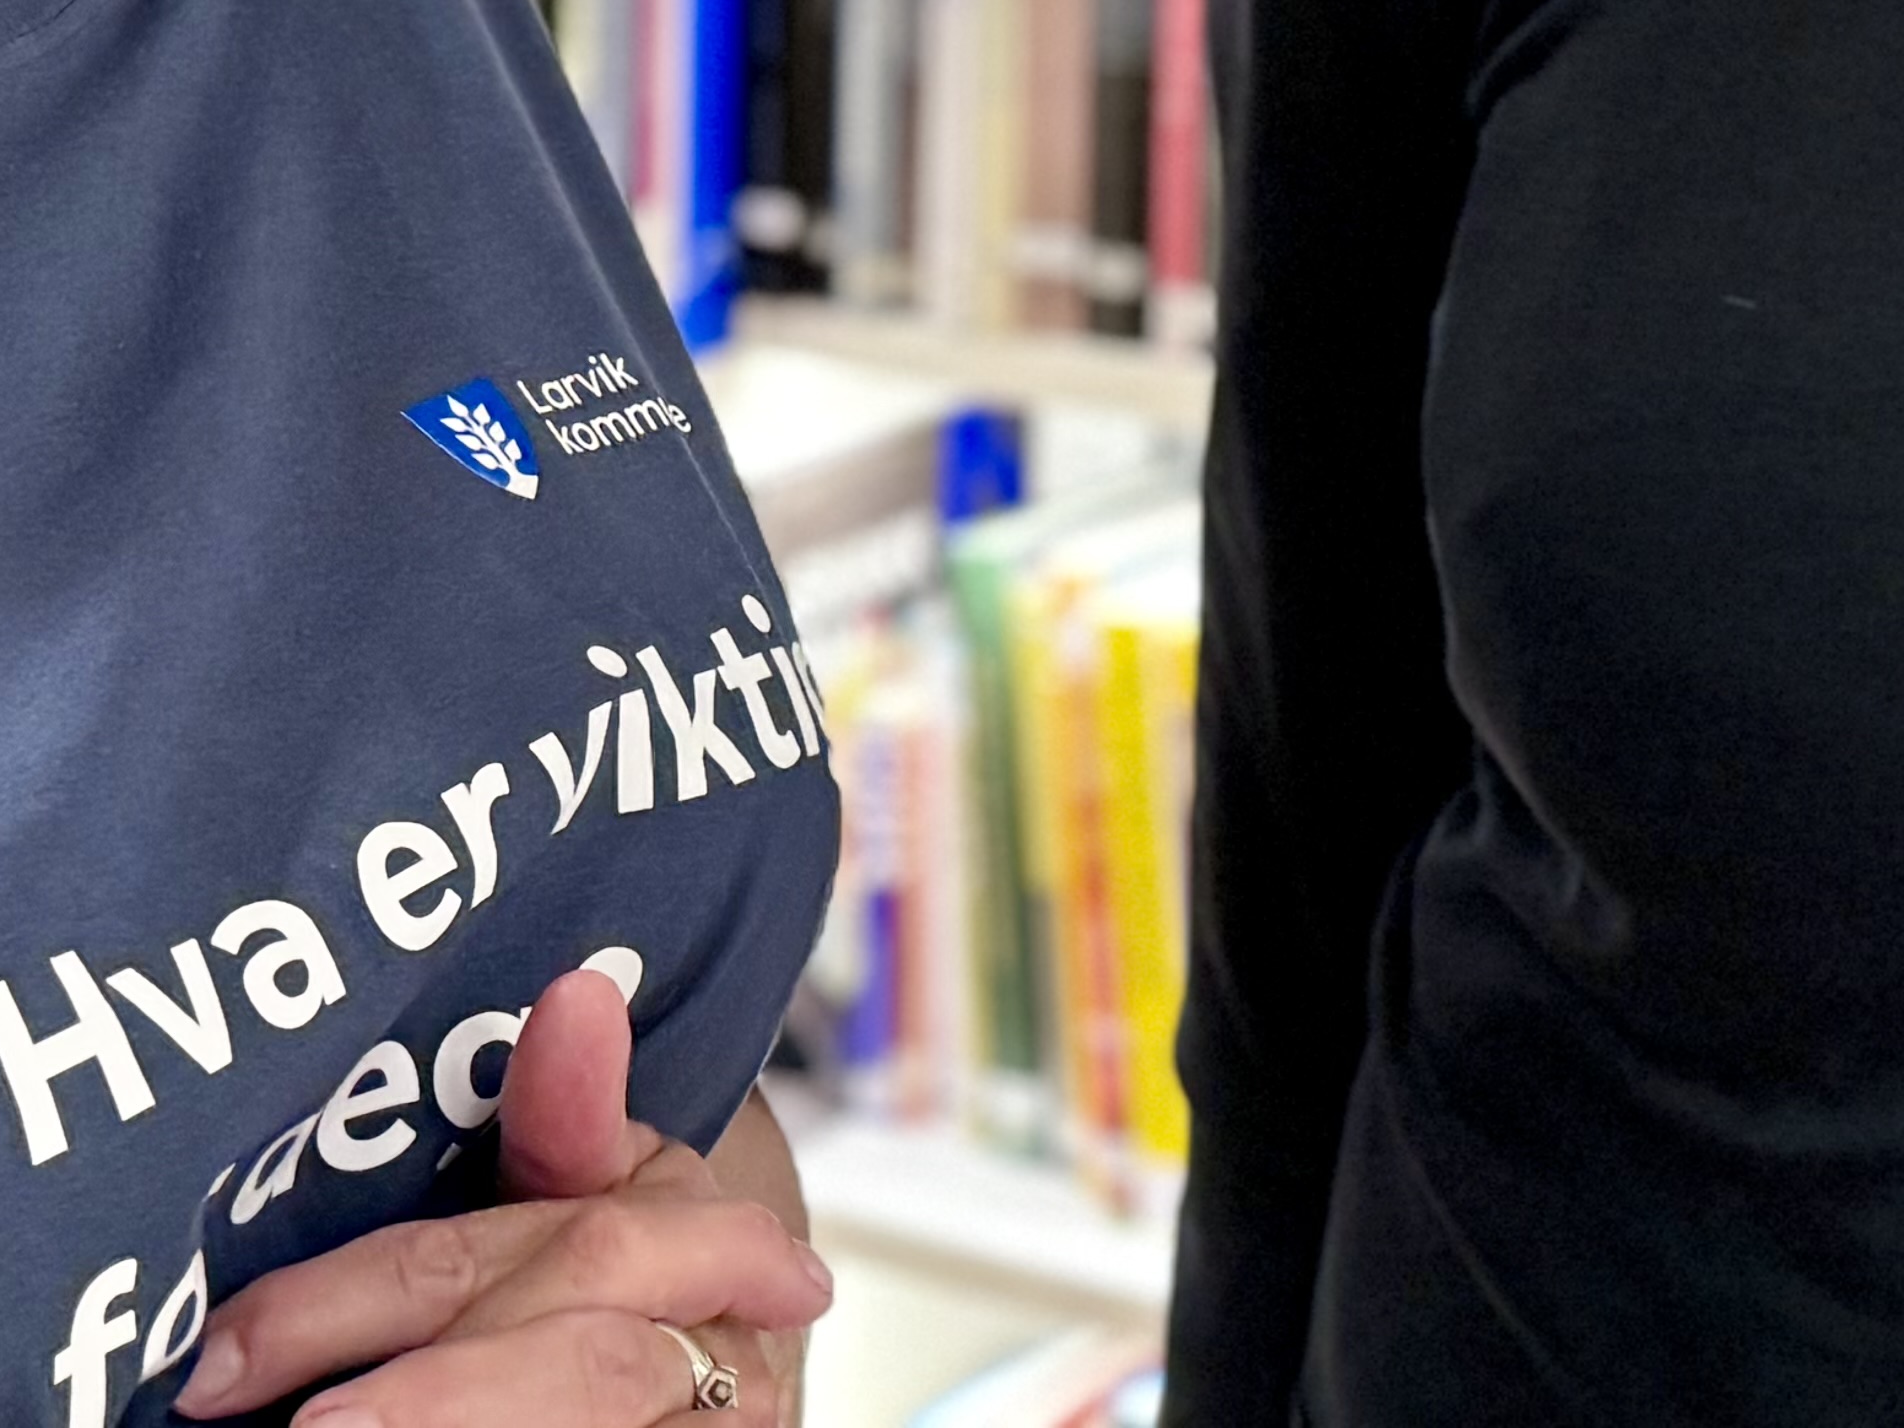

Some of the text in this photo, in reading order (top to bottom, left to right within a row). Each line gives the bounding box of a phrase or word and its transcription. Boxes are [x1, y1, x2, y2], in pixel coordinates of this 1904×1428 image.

[516, 352, 640, 416] Larvik
[545, 396, 693, 456] komme
[356, 761, 511, 952] er
[52, 1161, 238, 1428] fo
